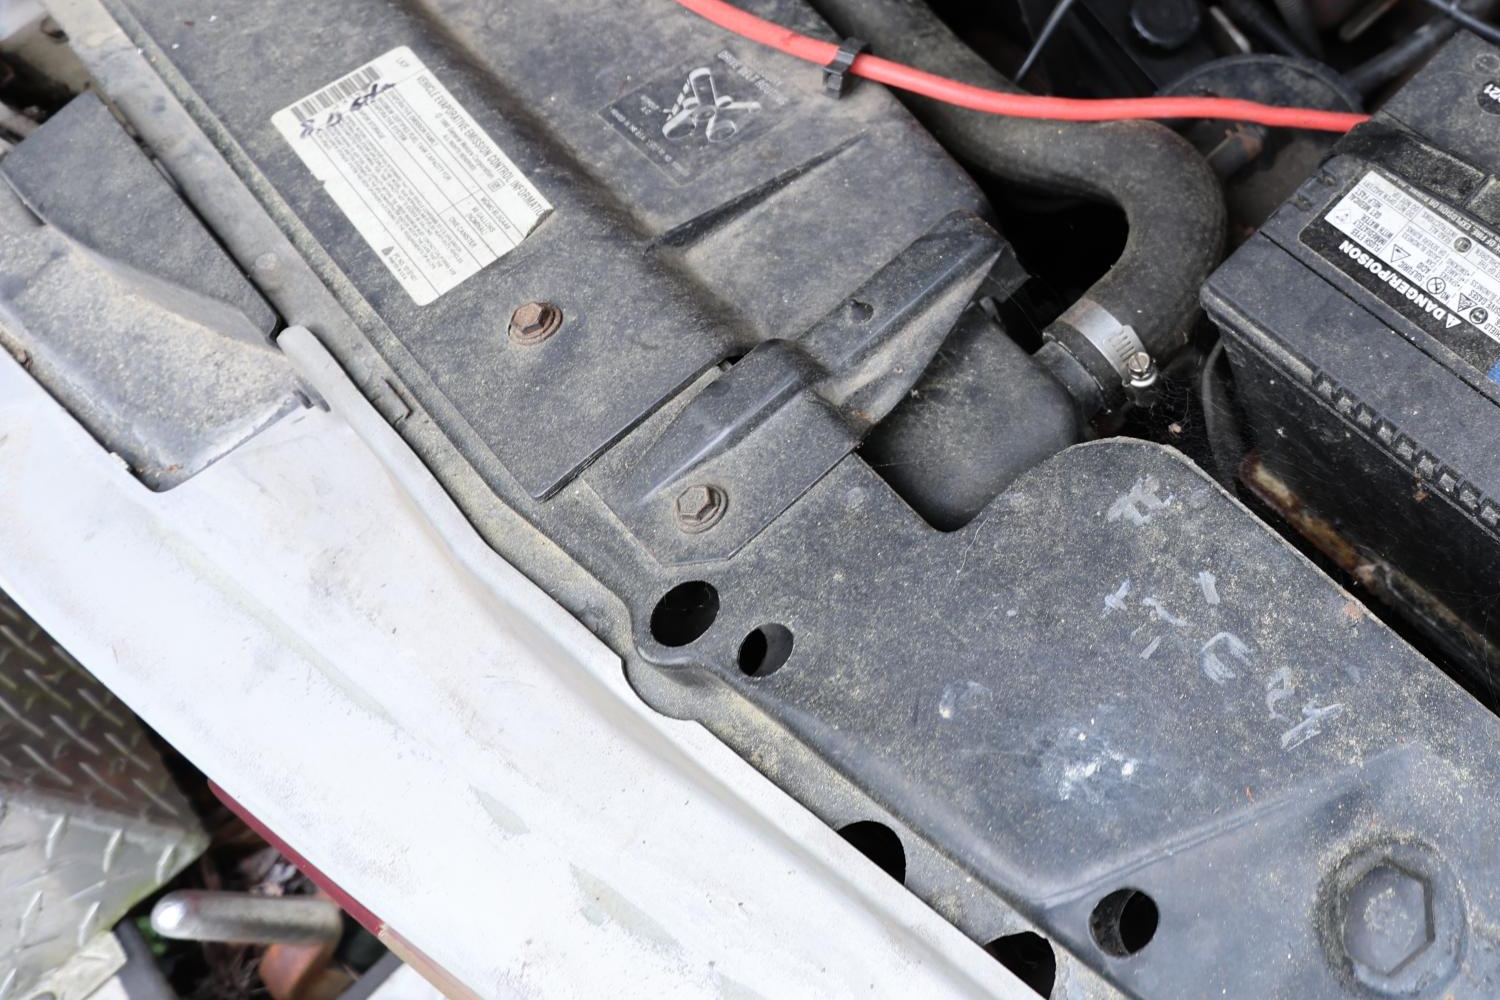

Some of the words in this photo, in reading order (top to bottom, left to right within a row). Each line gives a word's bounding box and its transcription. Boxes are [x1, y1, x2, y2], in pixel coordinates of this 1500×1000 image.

[415, 73, 440, 97] VEHICLE
[433, 94, 469, 130] EVAPORATIVE
[462, 126, 493, 157] EMISSION
[486, 153, 516, 182] CONTROL
[1346, 193, 1372, 212] MEDICAL
[1367, 196, 1383, 209] HELP
[1427, 197, 1439, 209] OR
[1368, 208, 1382, 219] GET
[1436, 203, 1471, 230] EXPLOSION
[1352, 218, 1388, 245] IMMEDIATELY
[1377, 226, 1394, 239] WITH
[1362, 236, 1382, 252] FLUSH
[1484, 236, 1496, 248] OF
[1397, 260, 1425, 282] SULFURIC
[1415, 261, 1431, 275] ACID
[1338, 240, 1447, 320] DANGER/POISON
[1439, 290, 1450, 301] NO
[1467, 288, 1488, 305] GASES
[1469, 279, 1497, 300] BLINDNESS
